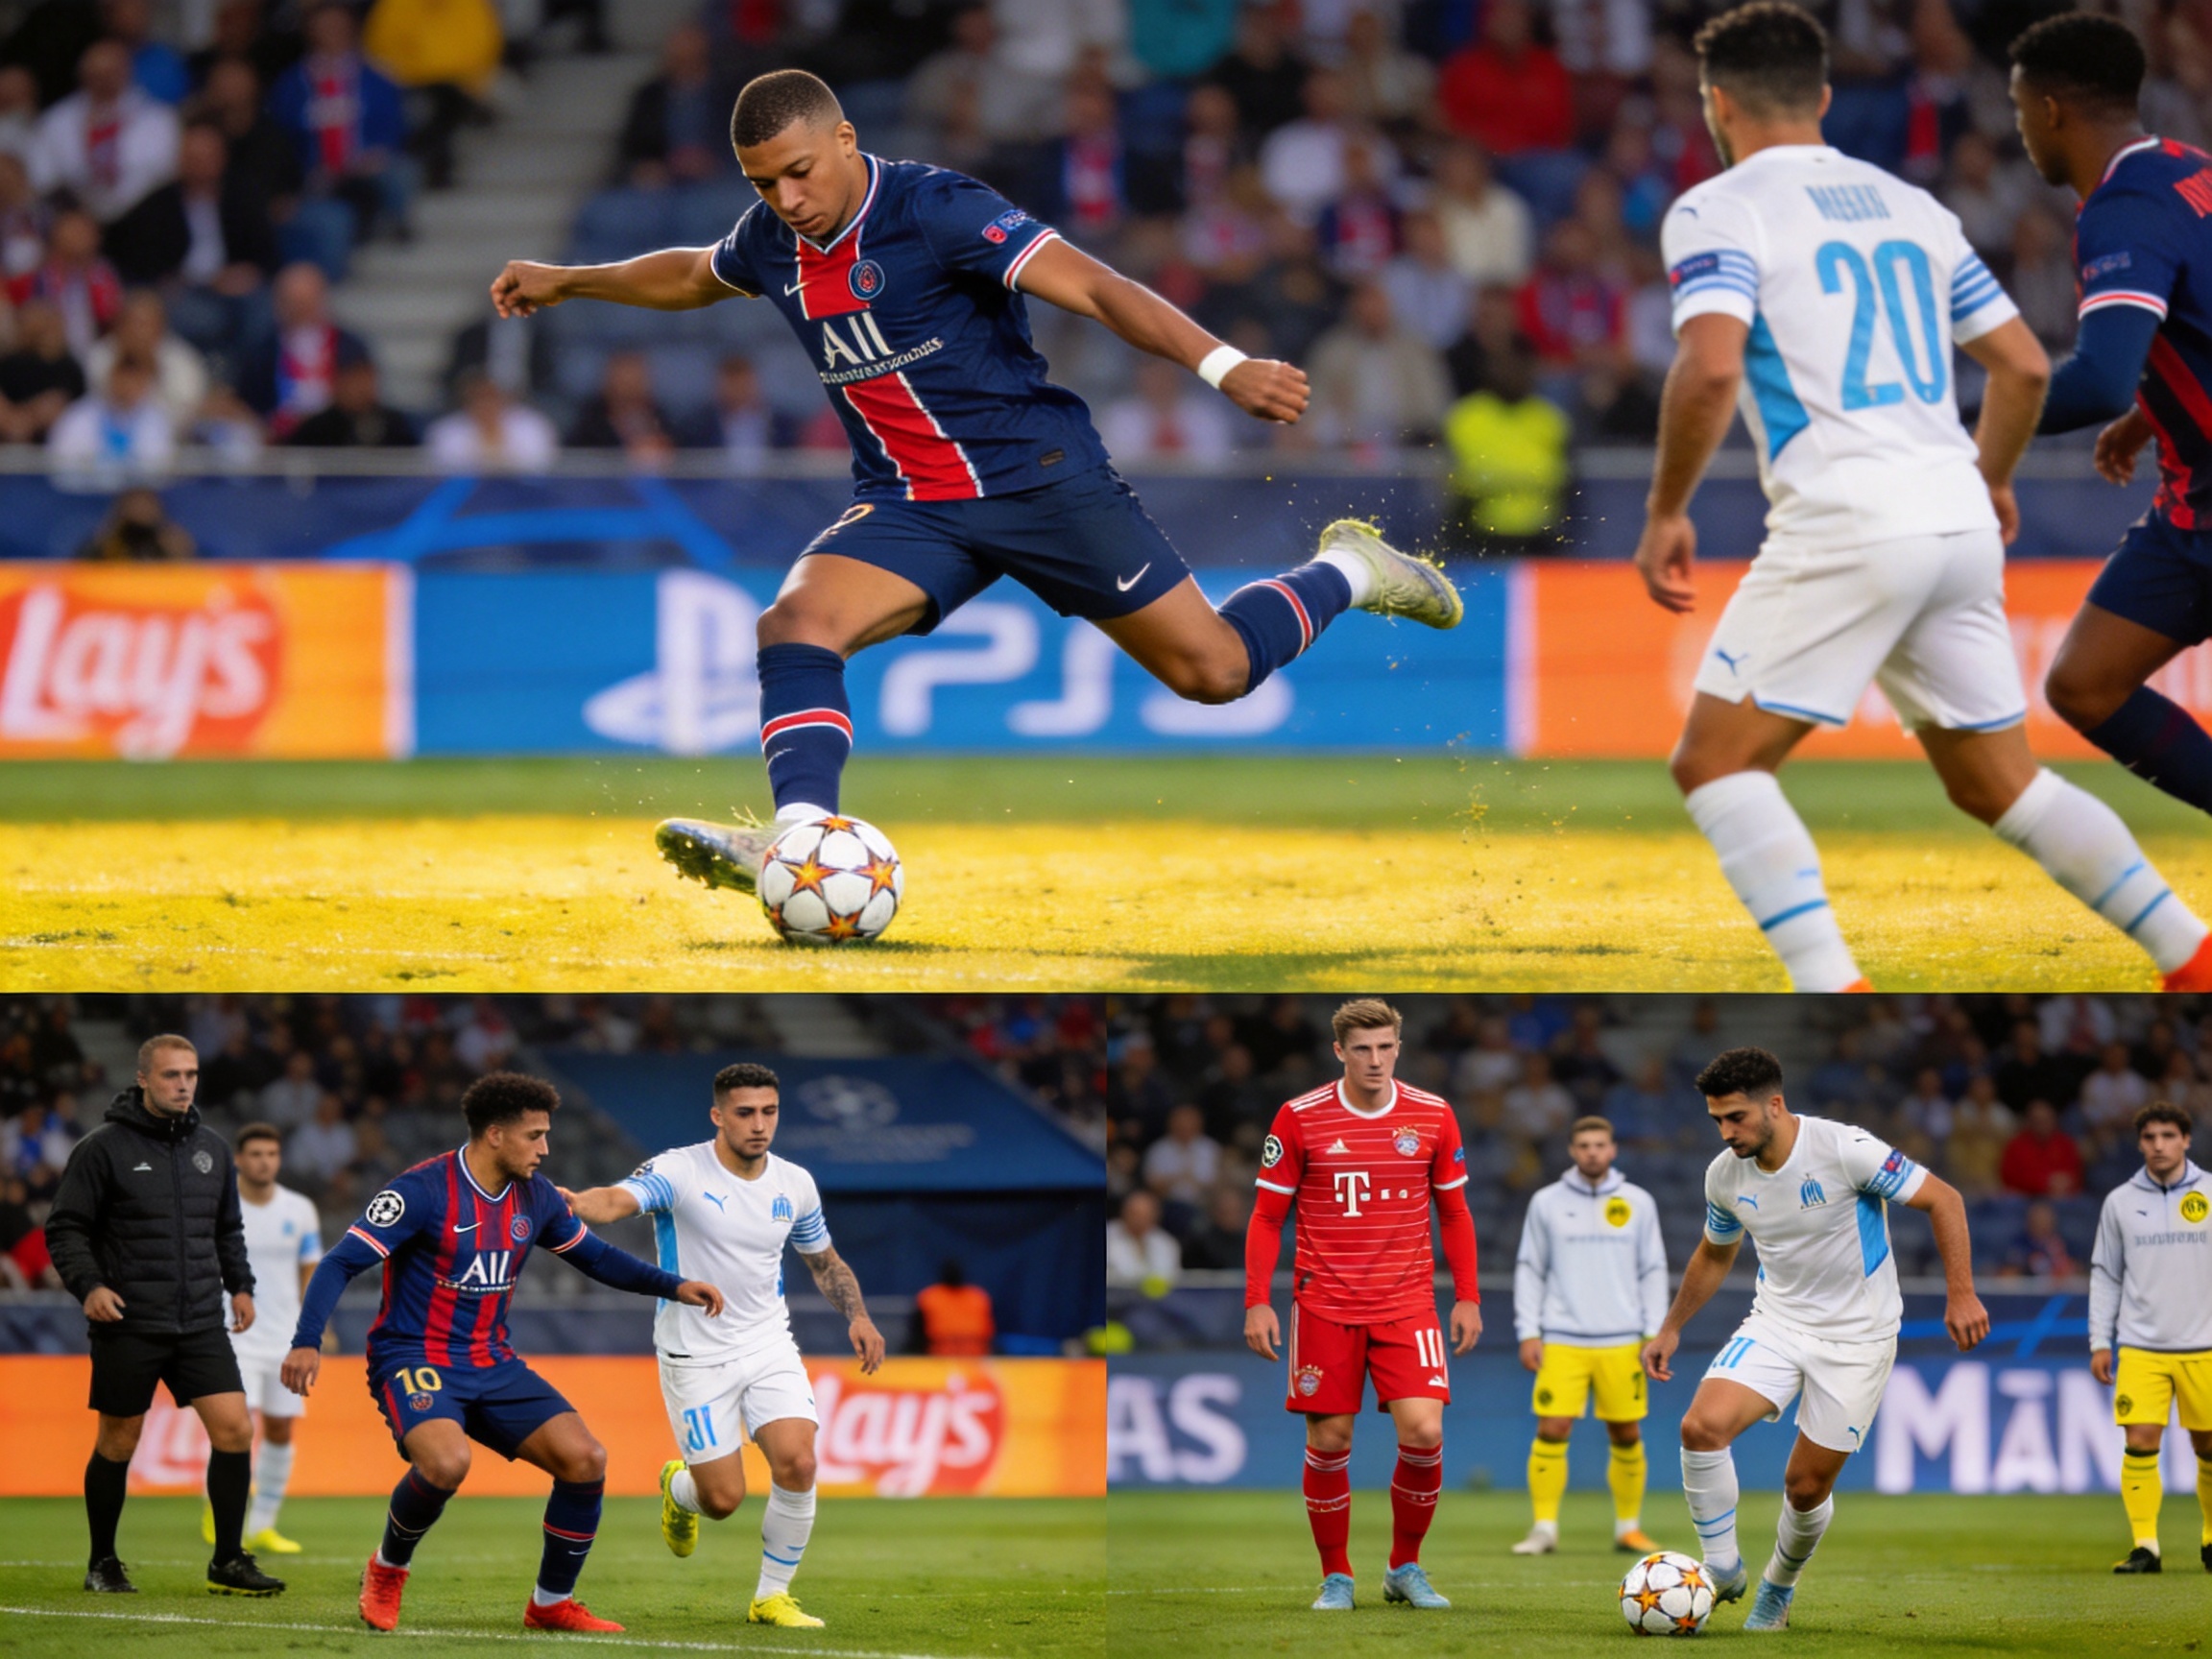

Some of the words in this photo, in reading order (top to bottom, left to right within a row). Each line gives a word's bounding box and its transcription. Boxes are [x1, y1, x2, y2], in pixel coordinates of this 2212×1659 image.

[1815, 240, 1947, 411] 20
[1, 582, 270, 762] Lay's
[395, 1367, 443, 1396] 10
